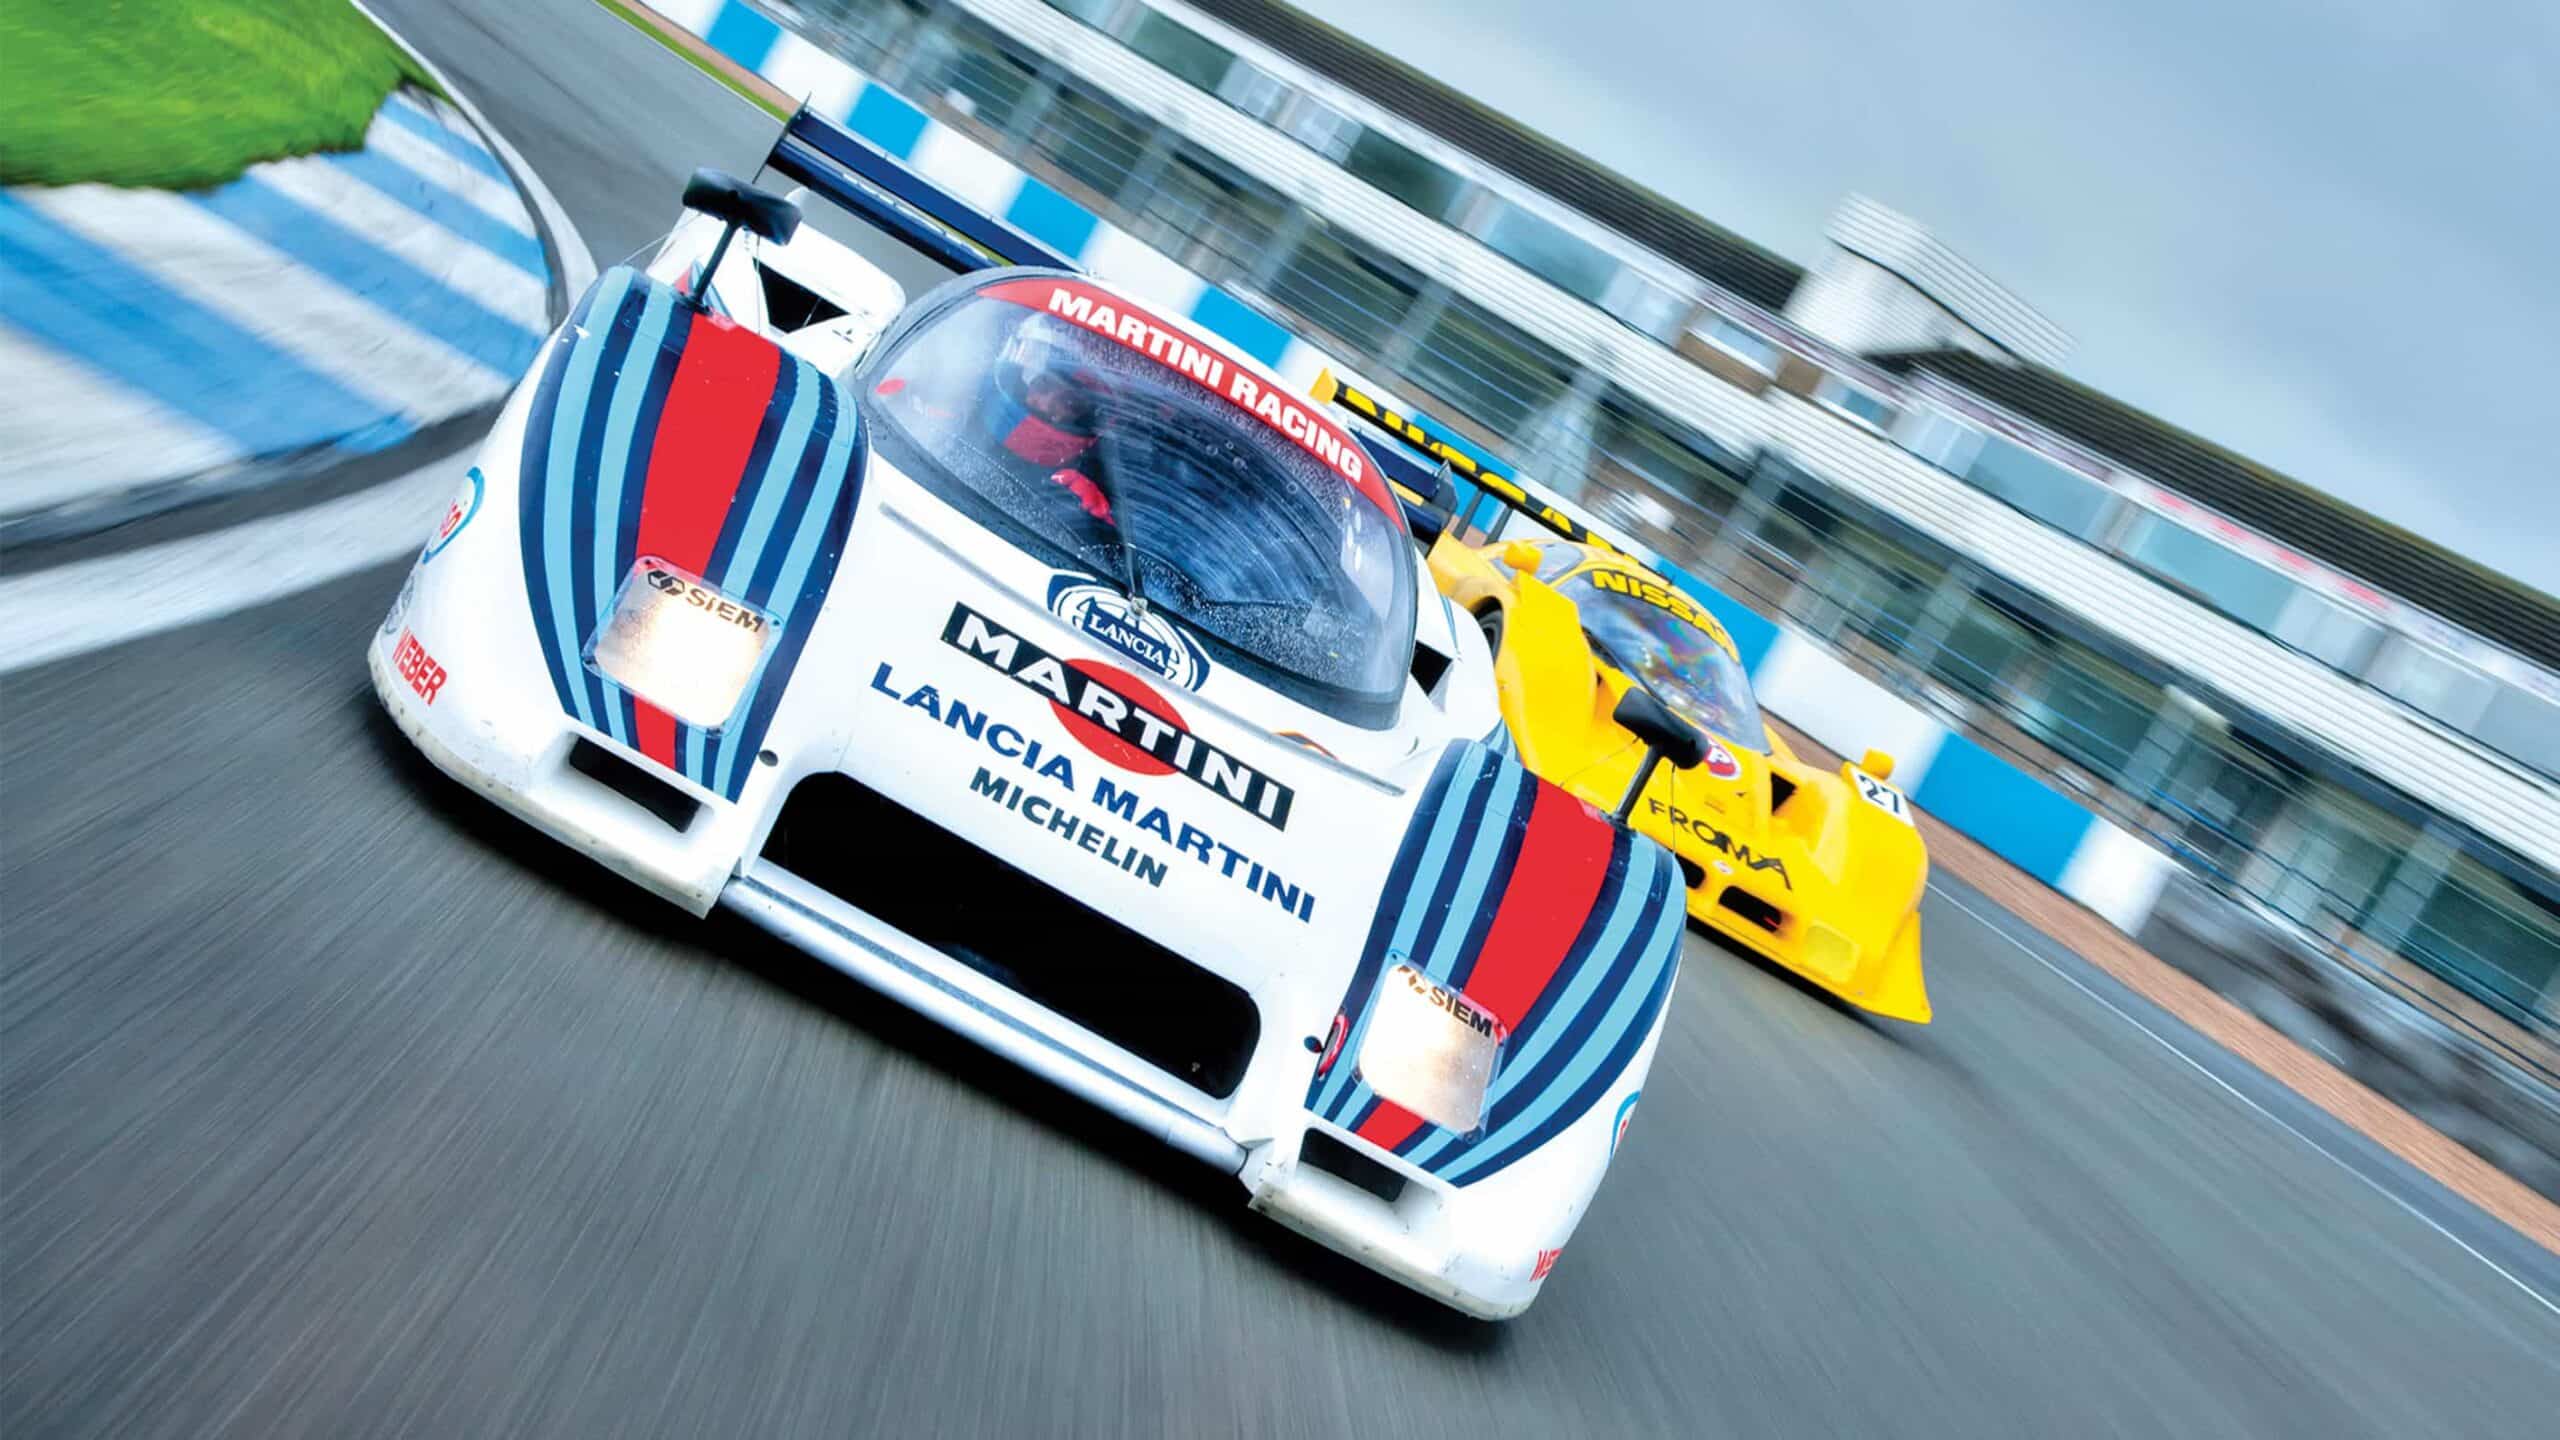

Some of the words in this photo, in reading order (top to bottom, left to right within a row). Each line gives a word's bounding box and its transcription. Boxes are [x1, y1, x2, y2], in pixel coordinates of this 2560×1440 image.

[1048, 287, 1224, 387] MARTINI
[1229, 372, 1363, 483] RACING
[686, 587, 766, 633] SIEM
[1088, 611, 1167, 668] LANCIA
[391, 624, 448, 706] WEBER
[956, 612, 1281, 823] MARTINI
[869, 660, 1076, 792] LANCIA
[1091, 776, 1317, 924] MARTINI
[968, 765, 1169, 888] MICHELIN
[1429, 985, 1494, 1038] SIEM
